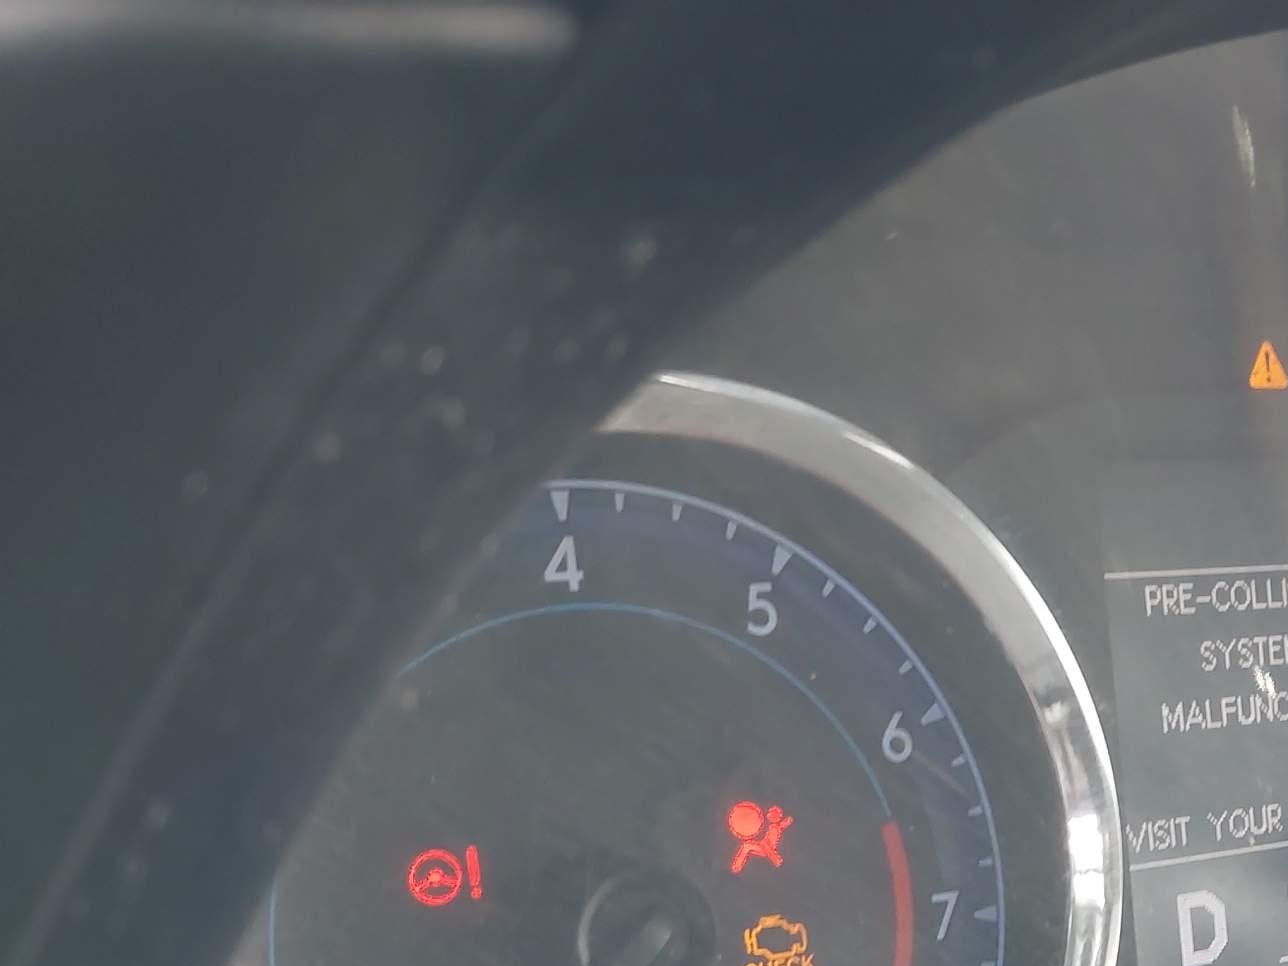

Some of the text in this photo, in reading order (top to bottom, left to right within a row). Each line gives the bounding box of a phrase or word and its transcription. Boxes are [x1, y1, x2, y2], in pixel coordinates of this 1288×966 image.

[543, 535, 585, 593] 4
[745, 581, 779, 637] 5
[880, 710, 914, 764] 6
[1125, 815, 1191, 854] VISIT
[1206, 802, 1284, 842] YOUR
[930, 889, 960, 942] 7
